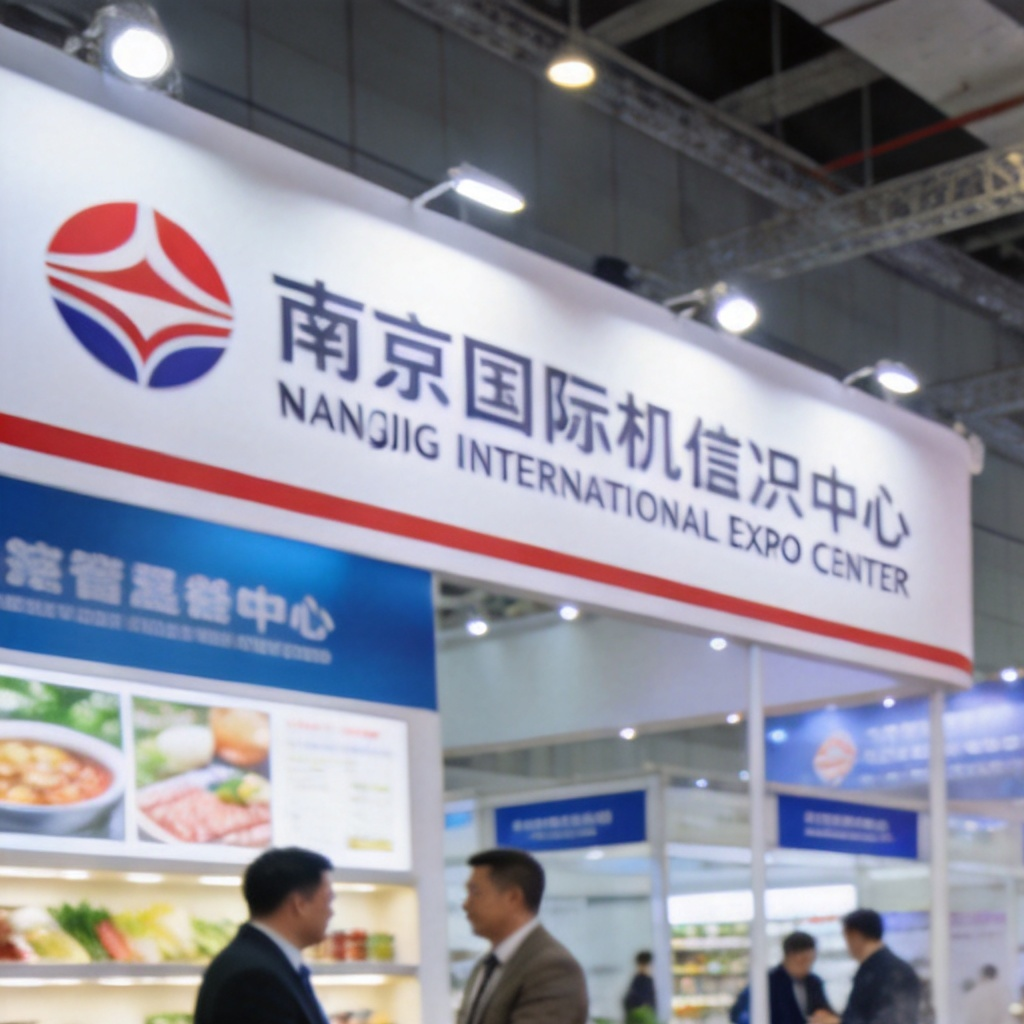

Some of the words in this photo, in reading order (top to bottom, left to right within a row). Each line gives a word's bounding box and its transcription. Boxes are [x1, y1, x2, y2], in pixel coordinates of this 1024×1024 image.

[457, 432, 720, 544] INTERNATIONAL
[728, 513, 802, 566] EXPO
[811, 541, 910, 599] CENTER
